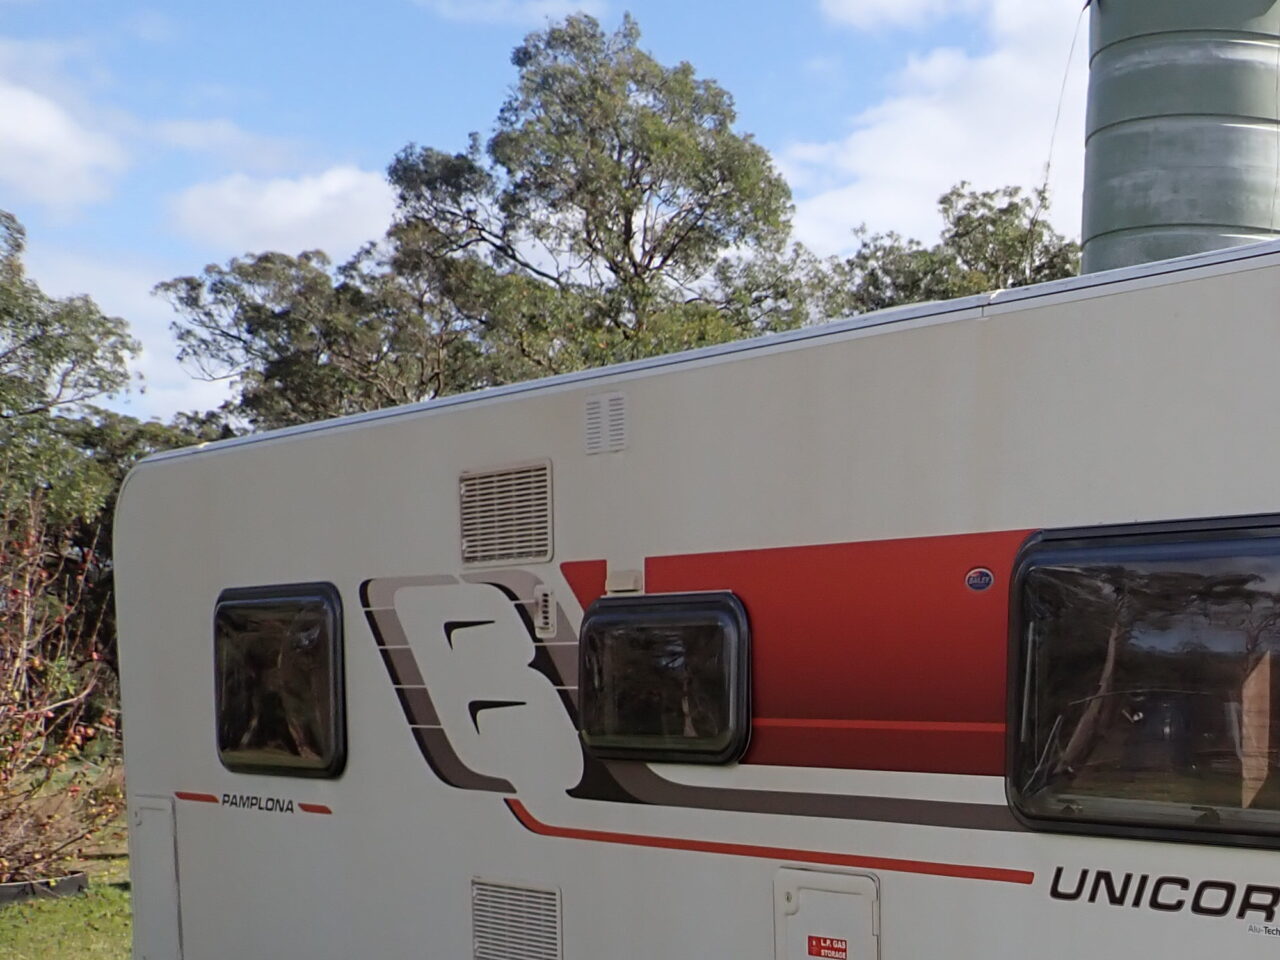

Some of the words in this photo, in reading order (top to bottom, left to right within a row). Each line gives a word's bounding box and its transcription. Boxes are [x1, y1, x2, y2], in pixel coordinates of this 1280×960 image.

[222, 793, 294, 814] PAMPLONA
[1248, 924, 1280, 936] Alu-Tech
[832, 940, 846, 949] GAS
[820, 949, 846, 959] STORAGE
